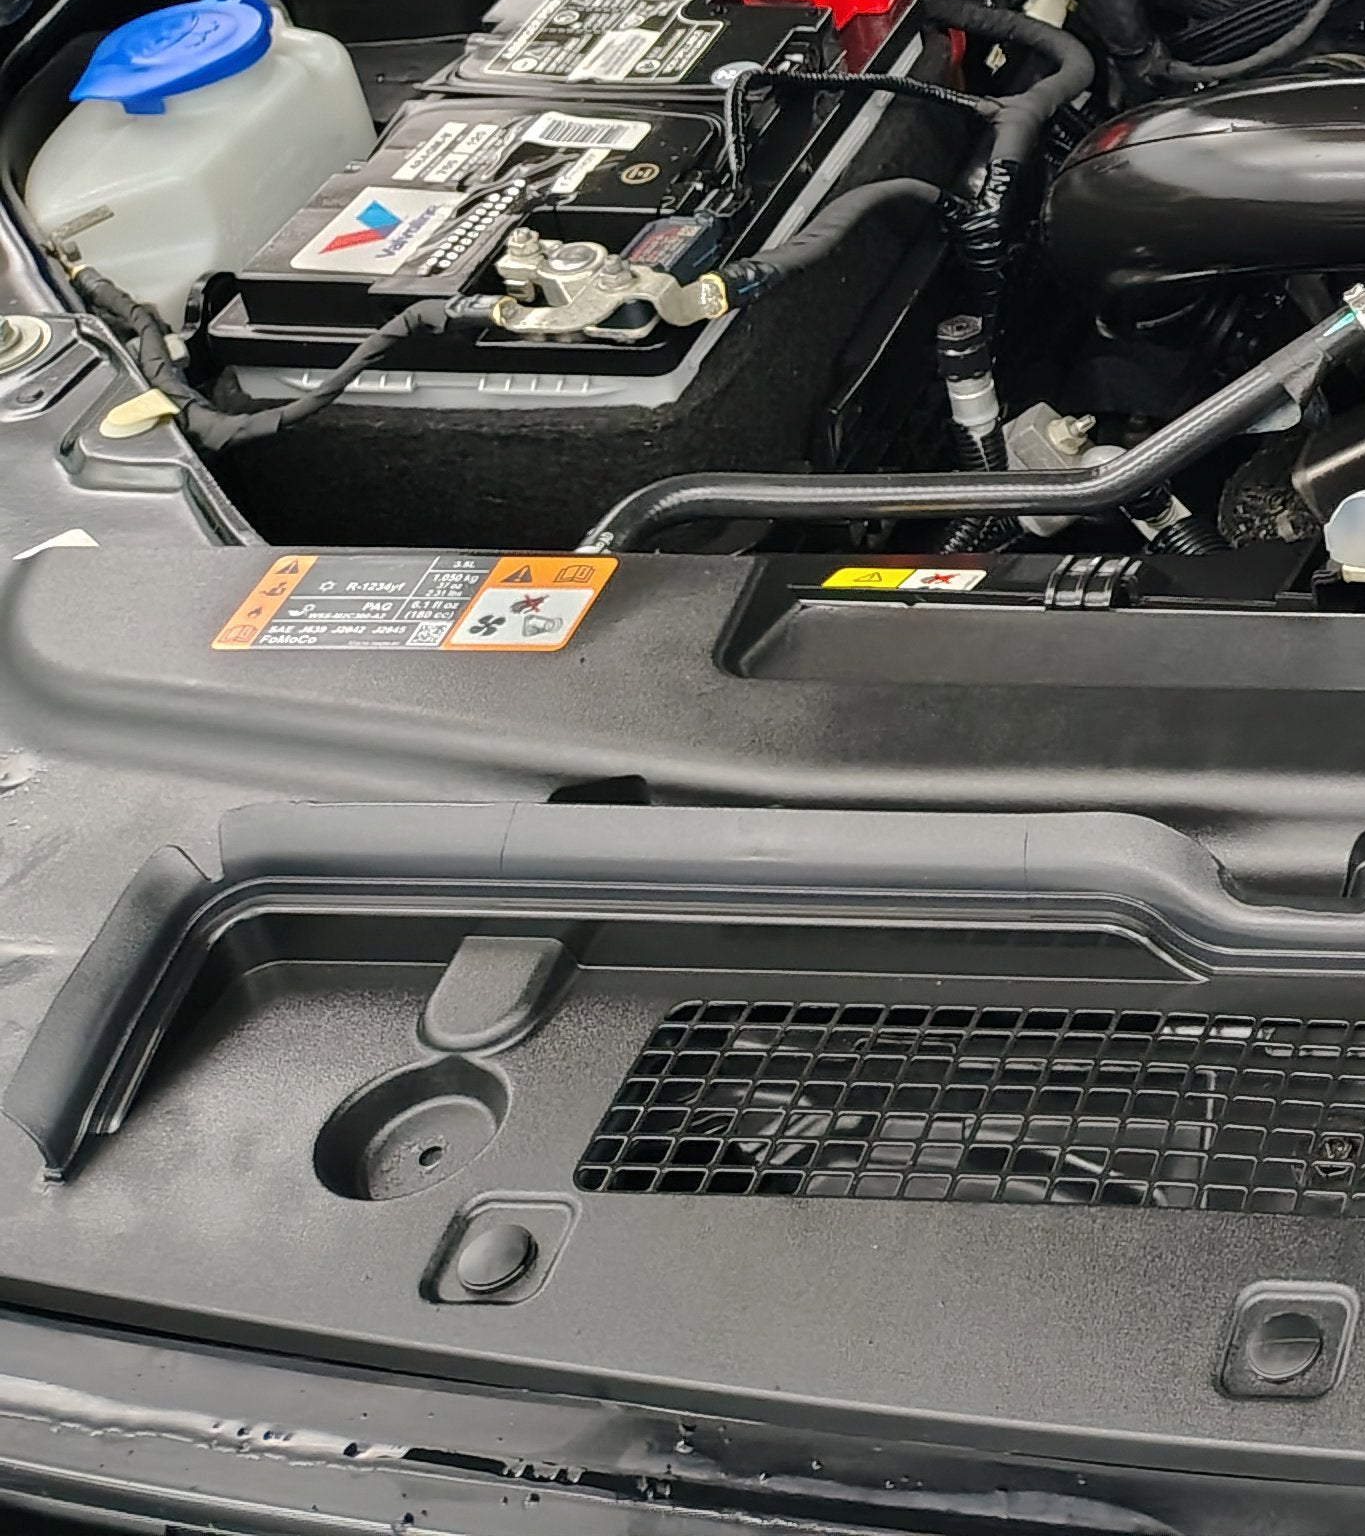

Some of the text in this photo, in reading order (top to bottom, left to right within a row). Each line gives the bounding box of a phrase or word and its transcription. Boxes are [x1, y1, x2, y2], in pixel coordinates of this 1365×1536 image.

[463, 573, 479, 584] kg
[345, 581, 406, 593] R-1234yf
[362, 601, 394, 611] PAG
[443, 602, 460, 610] oz
[268, 625, 295, 634] SAE
[259, 634, 318, 645] FoMoCo
